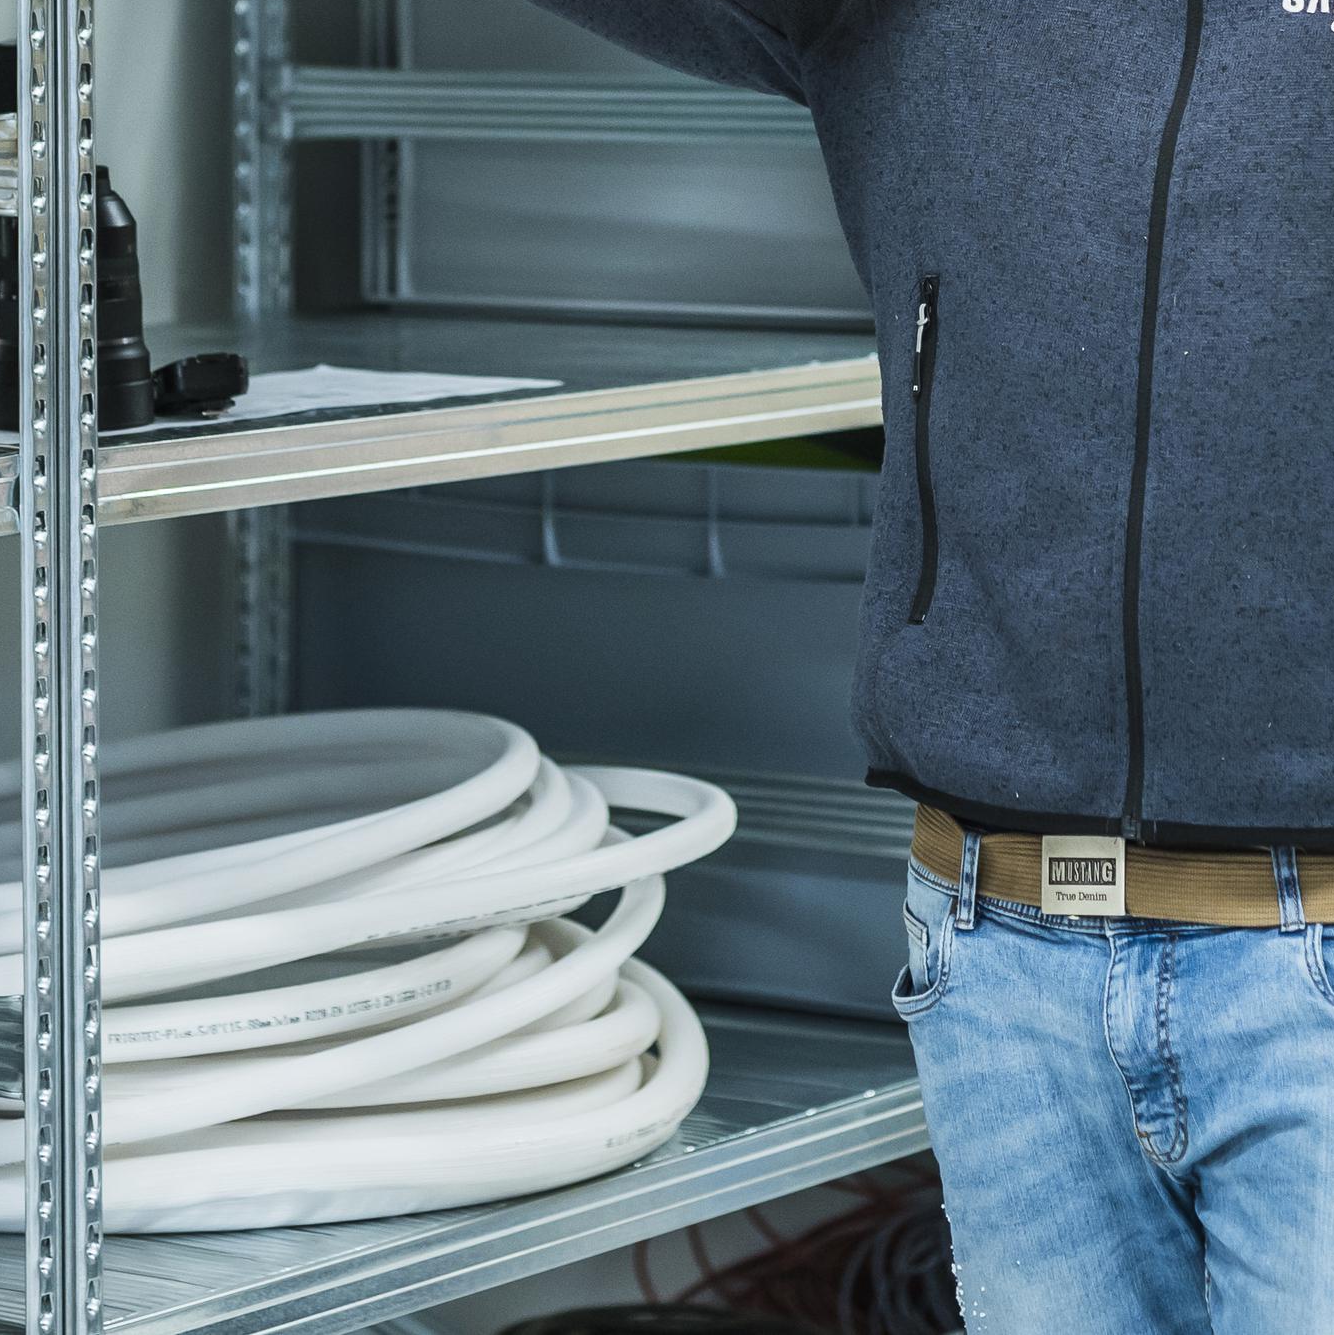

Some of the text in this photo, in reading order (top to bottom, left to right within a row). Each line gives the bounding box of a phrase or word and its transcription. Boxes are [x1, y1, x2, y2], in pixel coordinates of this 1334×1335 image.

[1051, 861, 1113, 882] MUSTANG
[1055, 891, 1107, 902] True Denim
